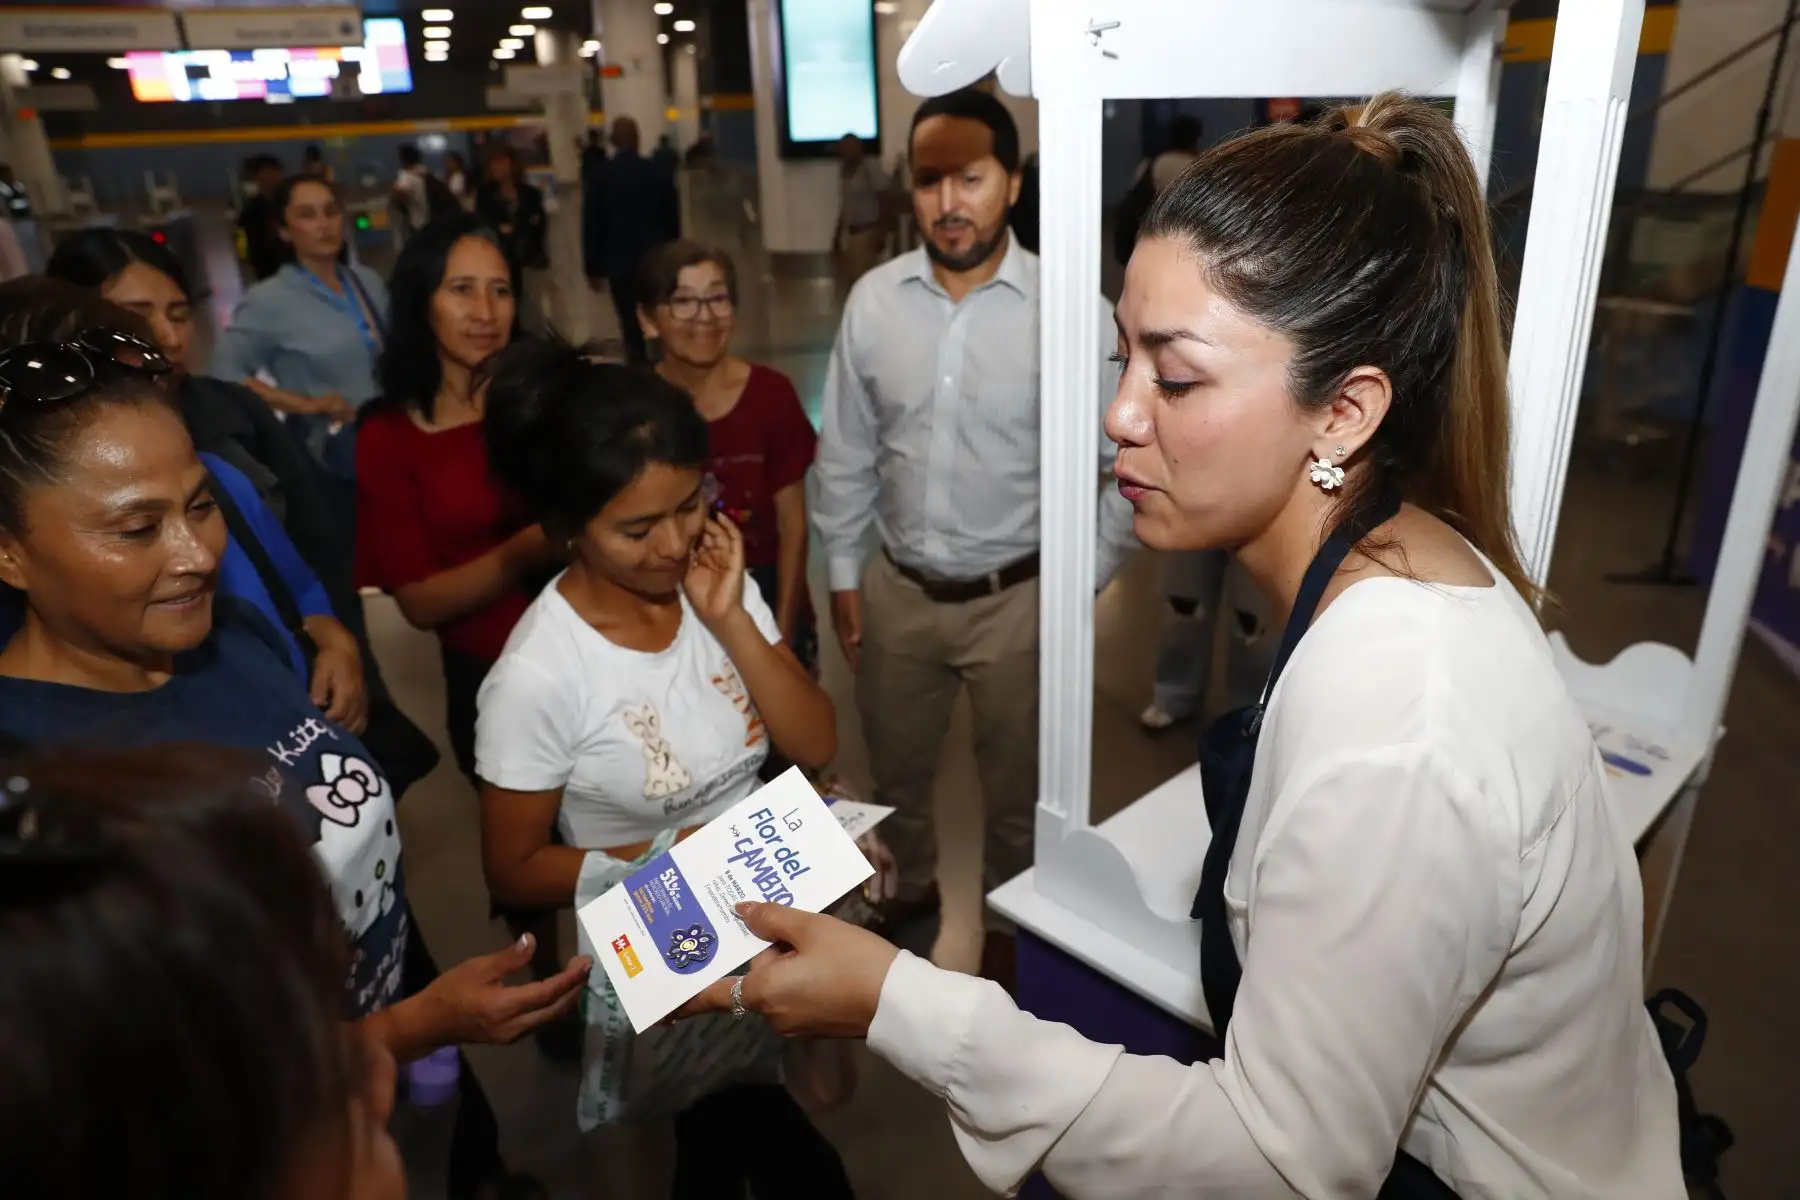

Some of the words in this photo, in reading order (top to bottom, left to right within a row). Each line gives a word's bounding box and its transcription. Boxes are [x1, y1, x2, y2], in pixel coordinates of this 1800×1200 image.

[748, 807, 784, 844] Flor
[774, 847, 811, 880] del
[782, 807, 803, 832] La
[660, 868, 680, 897] 51%
[727, 837, 794, 906] CAMBIO
